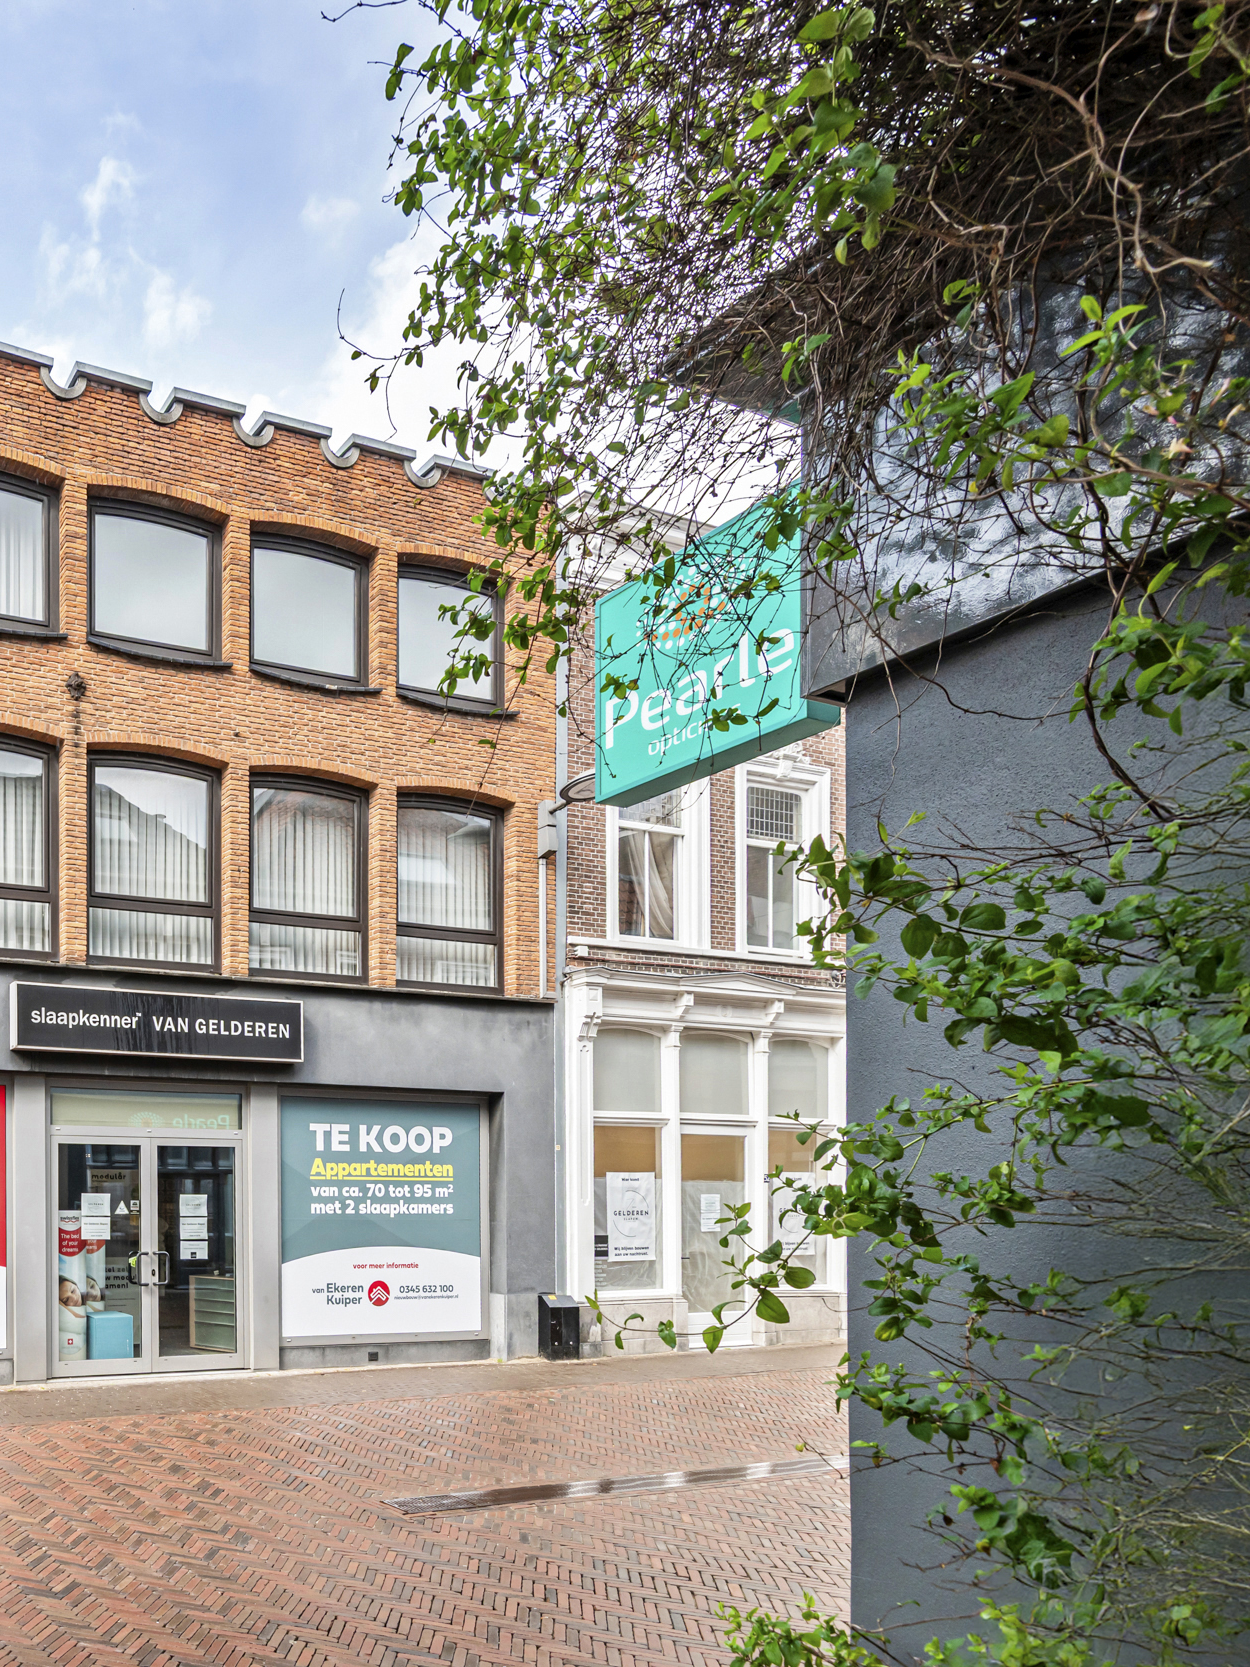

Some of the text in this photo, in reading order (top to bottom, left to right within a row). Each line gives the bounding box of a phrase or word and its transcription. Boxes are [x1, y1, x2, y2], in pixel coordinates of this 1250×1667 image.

[605, 627, 795, 750] Pearle
[648, 703, 741, 756] optici
[152, 1015, 189, 1033] VAN
[195, 1018, 290, 1039] GELDEREN
[309, 1122, 453, 1154] TE KOOP
[310, 1157, 454, 1180] Appartementen
[310, 1186, 338, 1197] van
[342, 1186, 363, 1197] ca.
[366, 1183, 385, 1197] 70
[388, 1184, 411, 1197] tot
[413, 1183, 432, 1198] 95
[310, 1200, 454, 1218] met 2 slaapkamers
[326, 1282, 364, 1293] Ekeren
[399, 1285, 421, 1294] 0345
[422, 1285, 437, 1293] 632
[438, 1284, 454, 1293] 100
[326, 1295, 363, 1307] Kuiper
